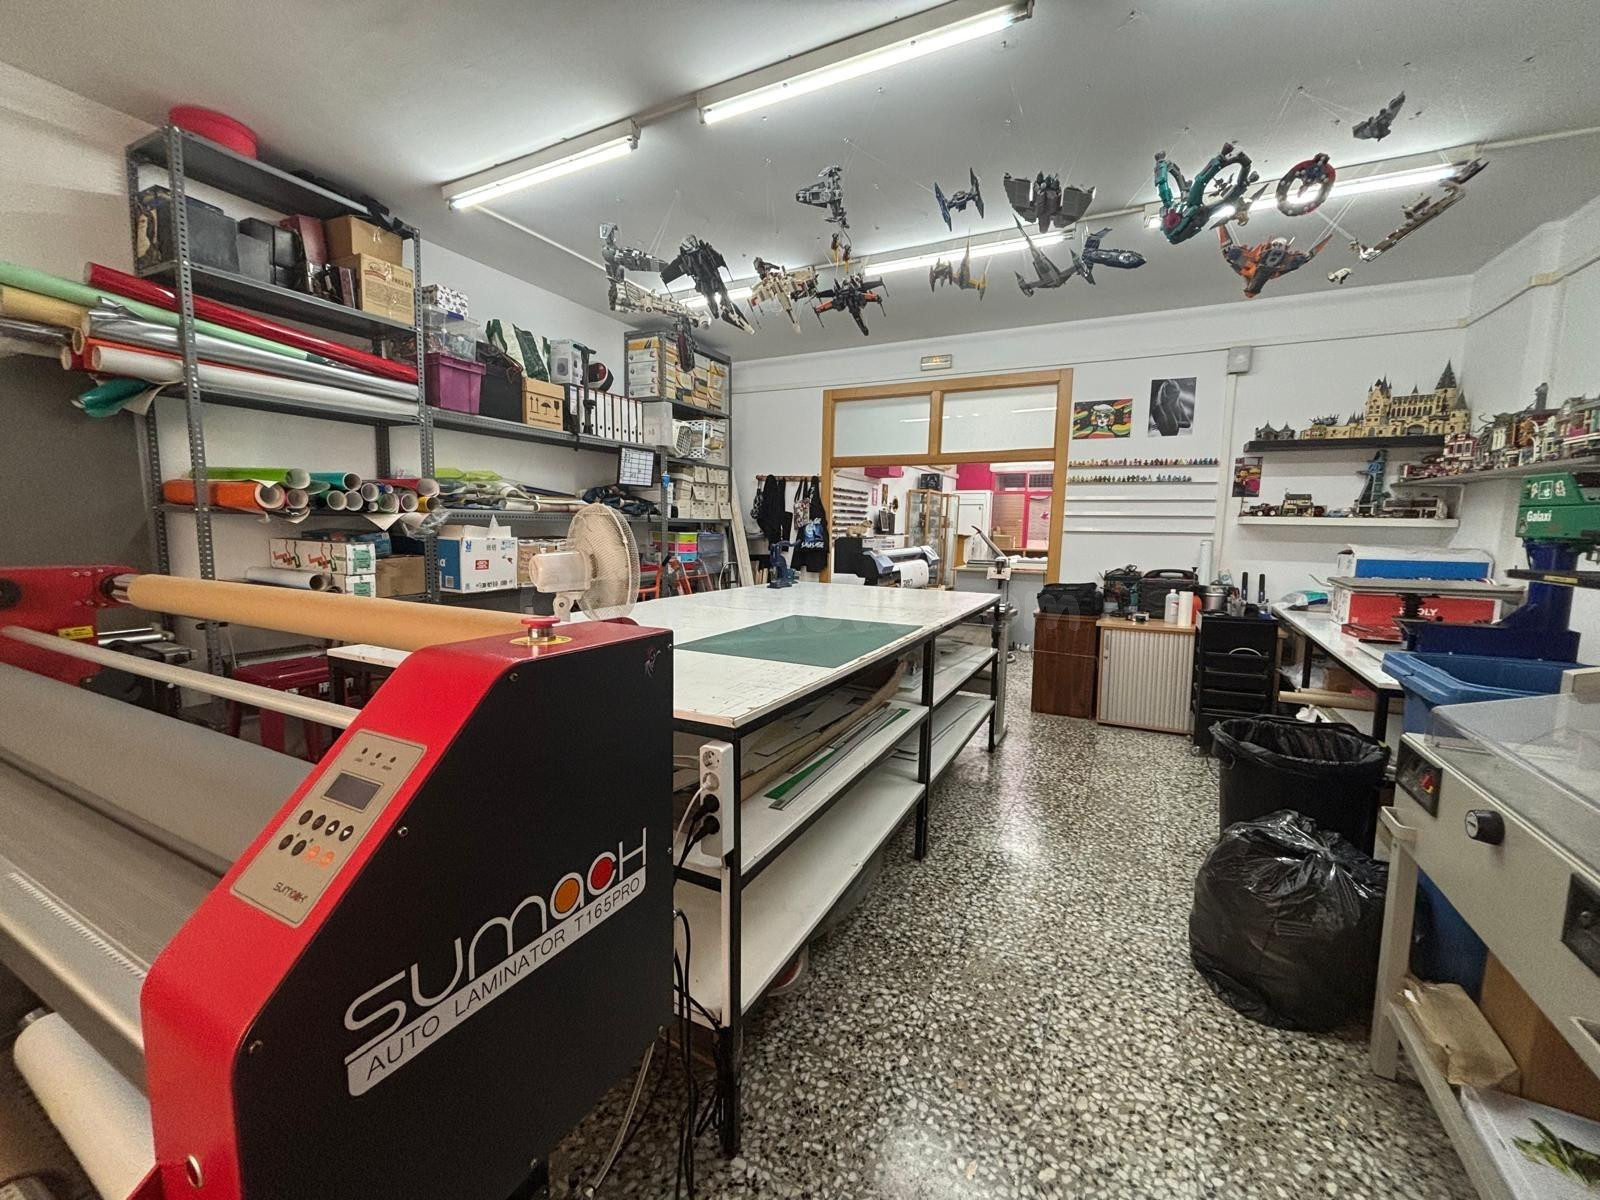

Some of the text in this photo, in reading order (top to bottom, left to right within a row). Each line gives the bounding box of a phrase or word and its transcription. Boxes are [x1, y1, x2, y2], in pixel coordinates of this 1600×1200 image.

[1526, 510, 1553, 522] Galaxi
[366, 877, 640, 1081] AUTO LAMINATOR T165PRO
